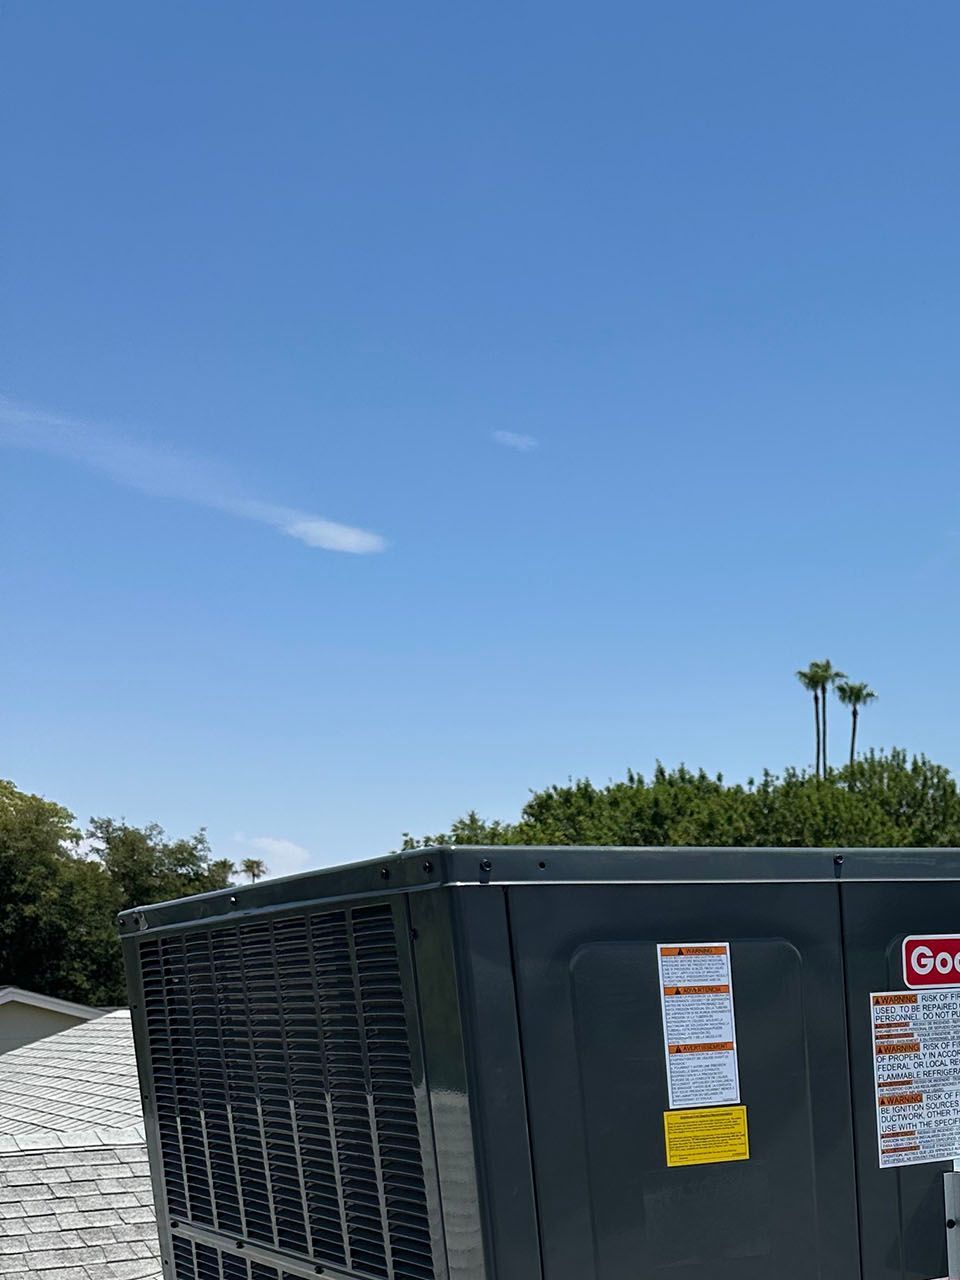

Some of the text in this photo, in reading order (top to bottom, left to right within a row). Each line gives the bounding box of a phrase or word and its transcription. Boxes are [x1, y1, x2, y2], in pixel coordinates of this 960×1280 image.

[880, 994, 916, 1004] WARNING
[921, 994, 937, 1002] RISK
[939, 993, 948, 1001] OF
[899, 1005, 909, 1013] TO
[911, 1004, 920, 1012] BE
[922, 1002, 957, 1011] REPAIRED
[884, 1043, 919, 1053] WARNING
[923, 1042, 939, 1051] RISK
[940, 1041, 950, 1049] OF
[876, 1055, 886, 1063] OF
[888, 1052, 927, 1062] PROPERLY
[928, 1051, 935, 1059] IN
[913, 1061, 924, 1069] OR
[925, 1059, 948, 1068] LOCAL
[878, 1070, 920, 1081] FLAMMABLE
[886, 1094, 921, 1105] WARNING
[926, 1093, 942, 1101] RISK
[880, 1106, 890, 1114] BE
[892, 1103, 923, 1113] IGNITION
[925, 1099, 959, 1110] SOURCES
[926, 1108, 951, 1118] OTHER
[881, 1124, 896, 1132] USE
[898, 1122, 916, 1130] WITH
[918, 1120, 932, 1128] THE
